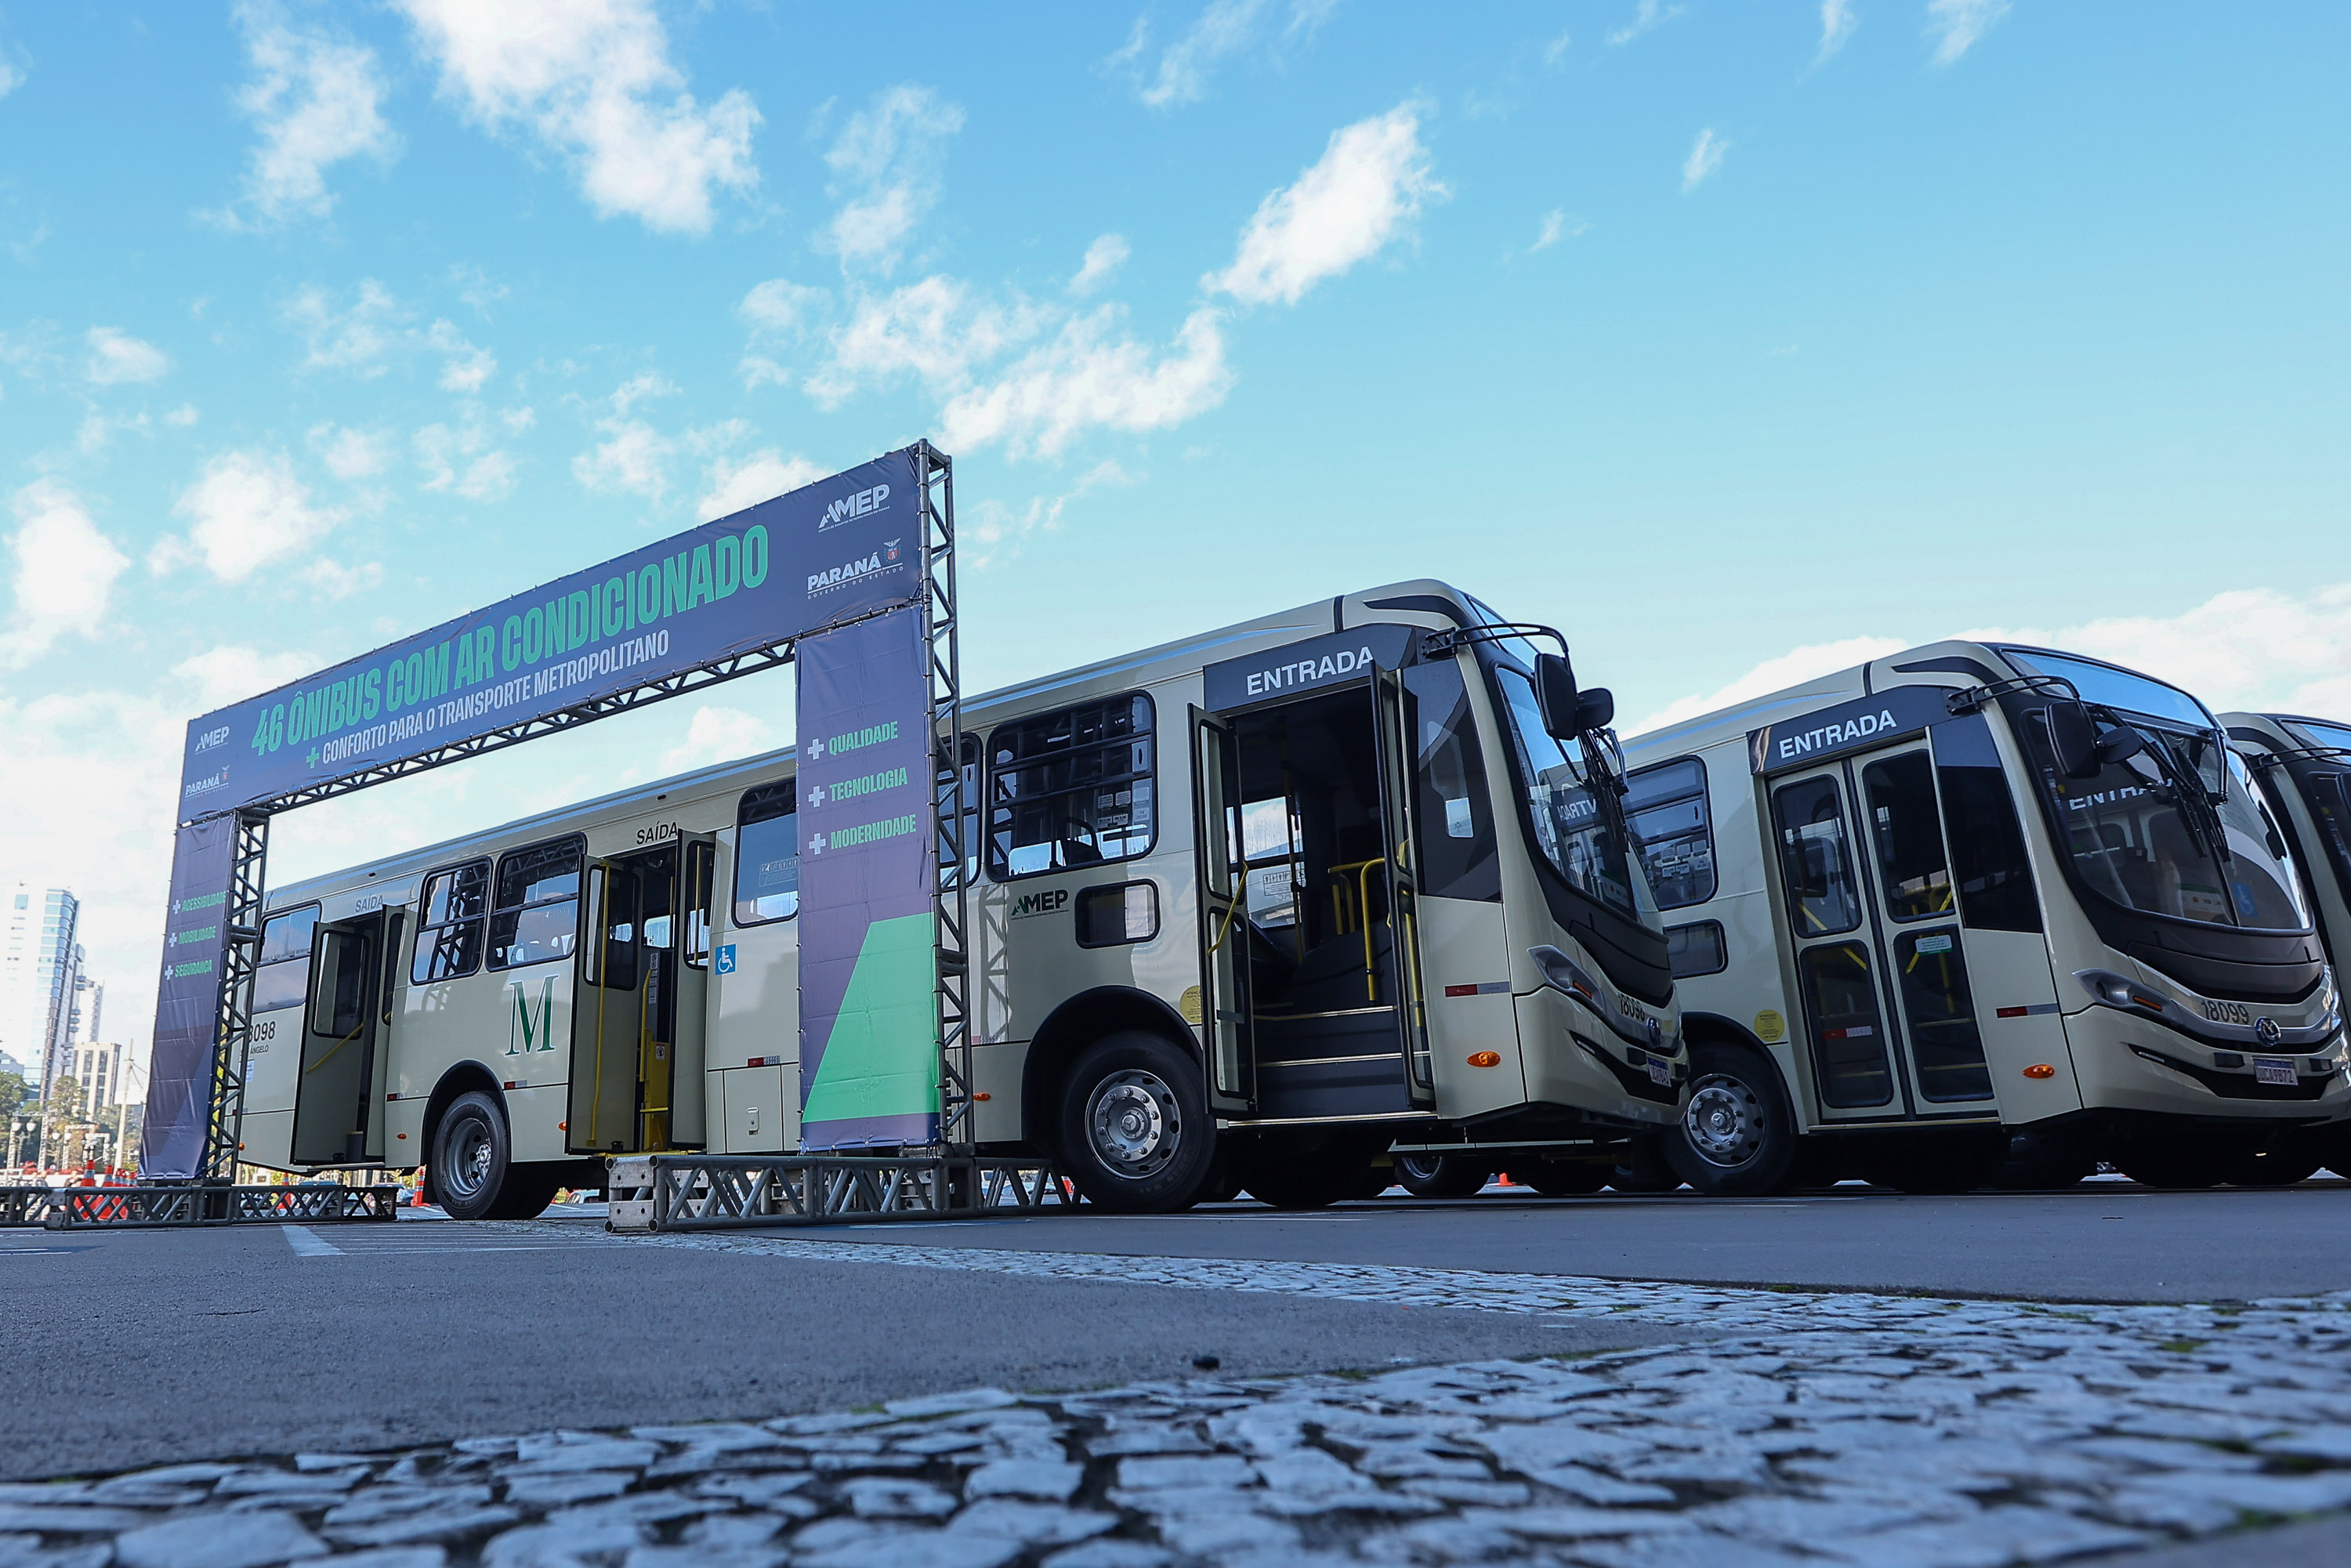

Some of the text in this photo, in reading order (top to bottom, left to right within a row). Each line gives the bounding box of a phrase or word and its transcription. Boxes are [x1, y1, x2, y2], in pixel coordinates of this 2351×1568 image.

[818, 483, 890, 529] AMEP
[807, 551, 882, 591] PARANÁ
[807, 583, 846, 599] GOVERNO
[868, 566, 904, 580] ESTADO
[251, 524, 769, 756] 46 ÔNIBUS COM AR CONDICIONADO
[1246, 646, 1374, 696] ENTRADA
[322, 723, 386, 765] CONFORTO
[388, 711, 423, 744] PARA
[426, 708, 436, 731] O
[437, 674, 531, 728] TRANSPORTE
[534, 629, 669, 697] METROPOLITANO
[194, 726, 230, 752] AMEP
[828, 720, 899, 756] QUALIDADE
[1779, 709, 1897, 759] ENTRADA
[185, 773, 220, 795] PARANÁ
[829, 766, 908, 802] TECNOLOGIA
[636, 820, 678, 845] SAÍDA
[831, 813, 916, 849] MODERNIDADE
[355, 893, 383, 913] SAÍDA
[1011, 889, 1069, 916] AMEP
[178, 925, 216, 944] MOBILIDADE
[175, 959, 212, 978] SEGURANÇA
[504, 974, 559, 1056] M
[2201, 999, 2249, 1025] 18099
